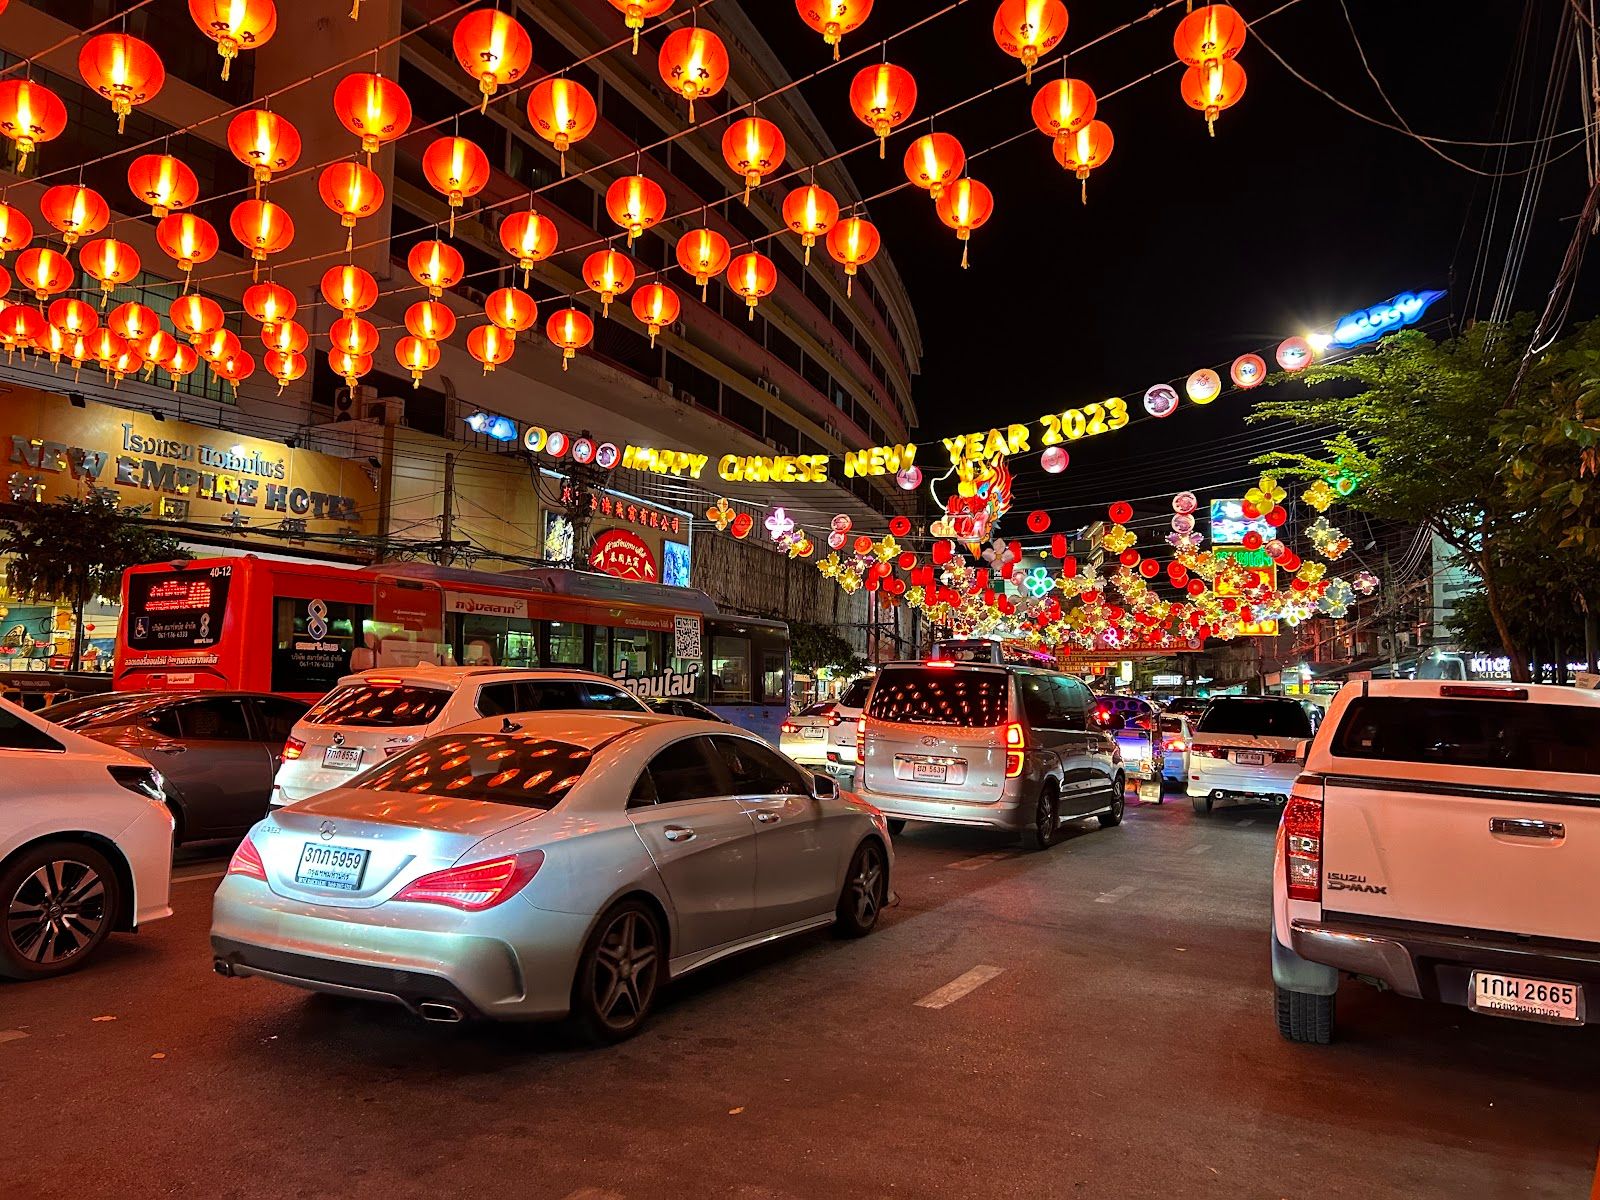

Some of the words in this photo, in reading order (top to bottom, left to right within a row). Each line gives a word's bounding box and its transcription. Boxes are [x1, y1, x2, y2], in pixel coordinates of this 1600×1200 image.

[121, 422, 194, 462] โรงแรม
[621, 444, 709, 479] HAPPY
[717, 453, 829, 484] CHINESE
[844, 442, 917, 478] NEW
[943, 424, 1031, 465] YEAR
[1039, 396, 1130, 446] 2023
[9, 434, 109, 482] NEW
[115, 454, 259, 506] EMPIRE
[264, 482, 362, 521] HOTEL
[210, 566, 232, 577] 40-12
[332, 851, 362, 870] 5959
[1327, 872, 1367, 883] ISUZU
[1327, 880, 1387, 895] D-MAX
[1525, 983, 1573, 1005] 2665
[1490, 1001, 1561, 1017] กรงเทพมหานคร
